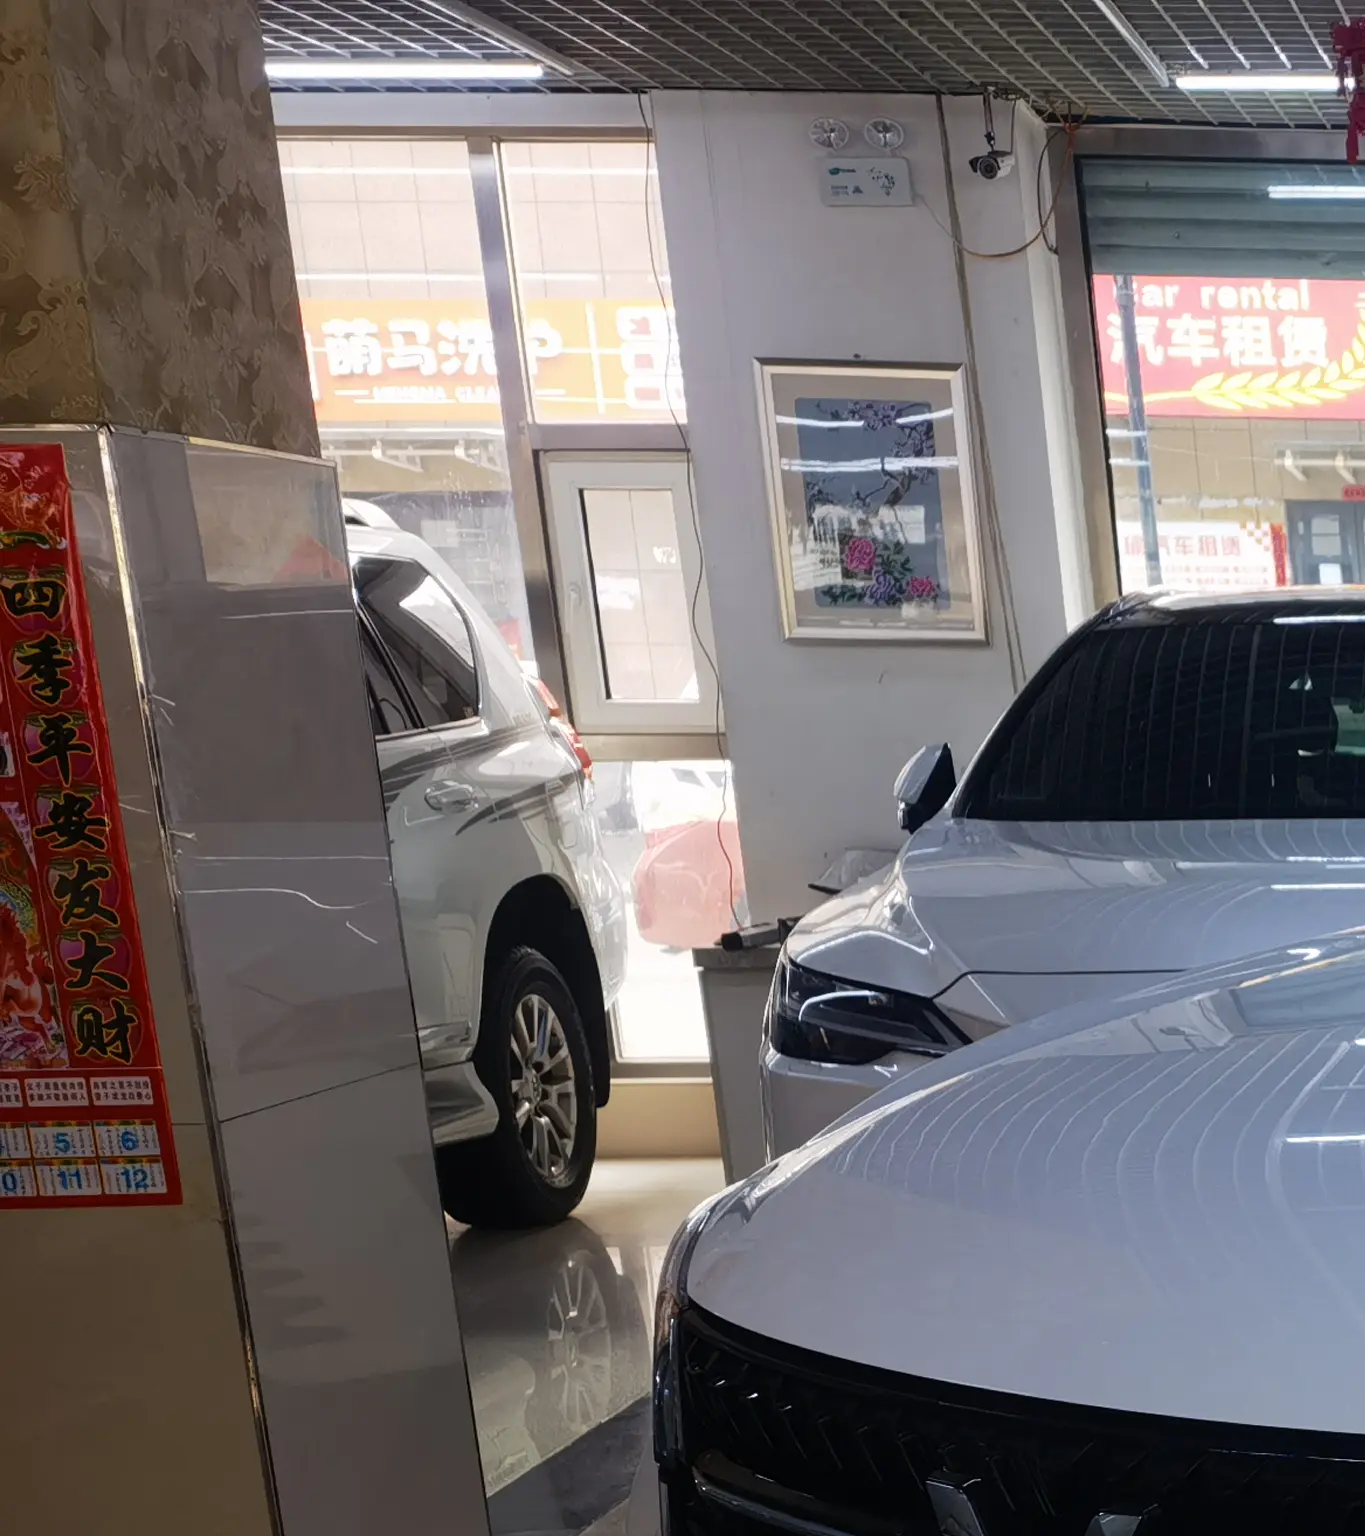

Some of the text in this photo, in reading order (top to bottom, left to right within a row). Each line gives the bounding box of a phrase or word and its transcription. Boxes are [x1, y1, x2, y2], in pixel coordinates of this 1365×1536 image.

[1201, 278, 1311, 311] rental
[1107, 313, 1330, 368] 汽车租赁
[0, 577, 138, 1065] 四季平安发大财
[55, 1131, 73, 1154] 5
[120, 1130, 139, 1151] 6
[59, 1169, 83, 1190] 11
[120, 1168, 149, 1191] 12
